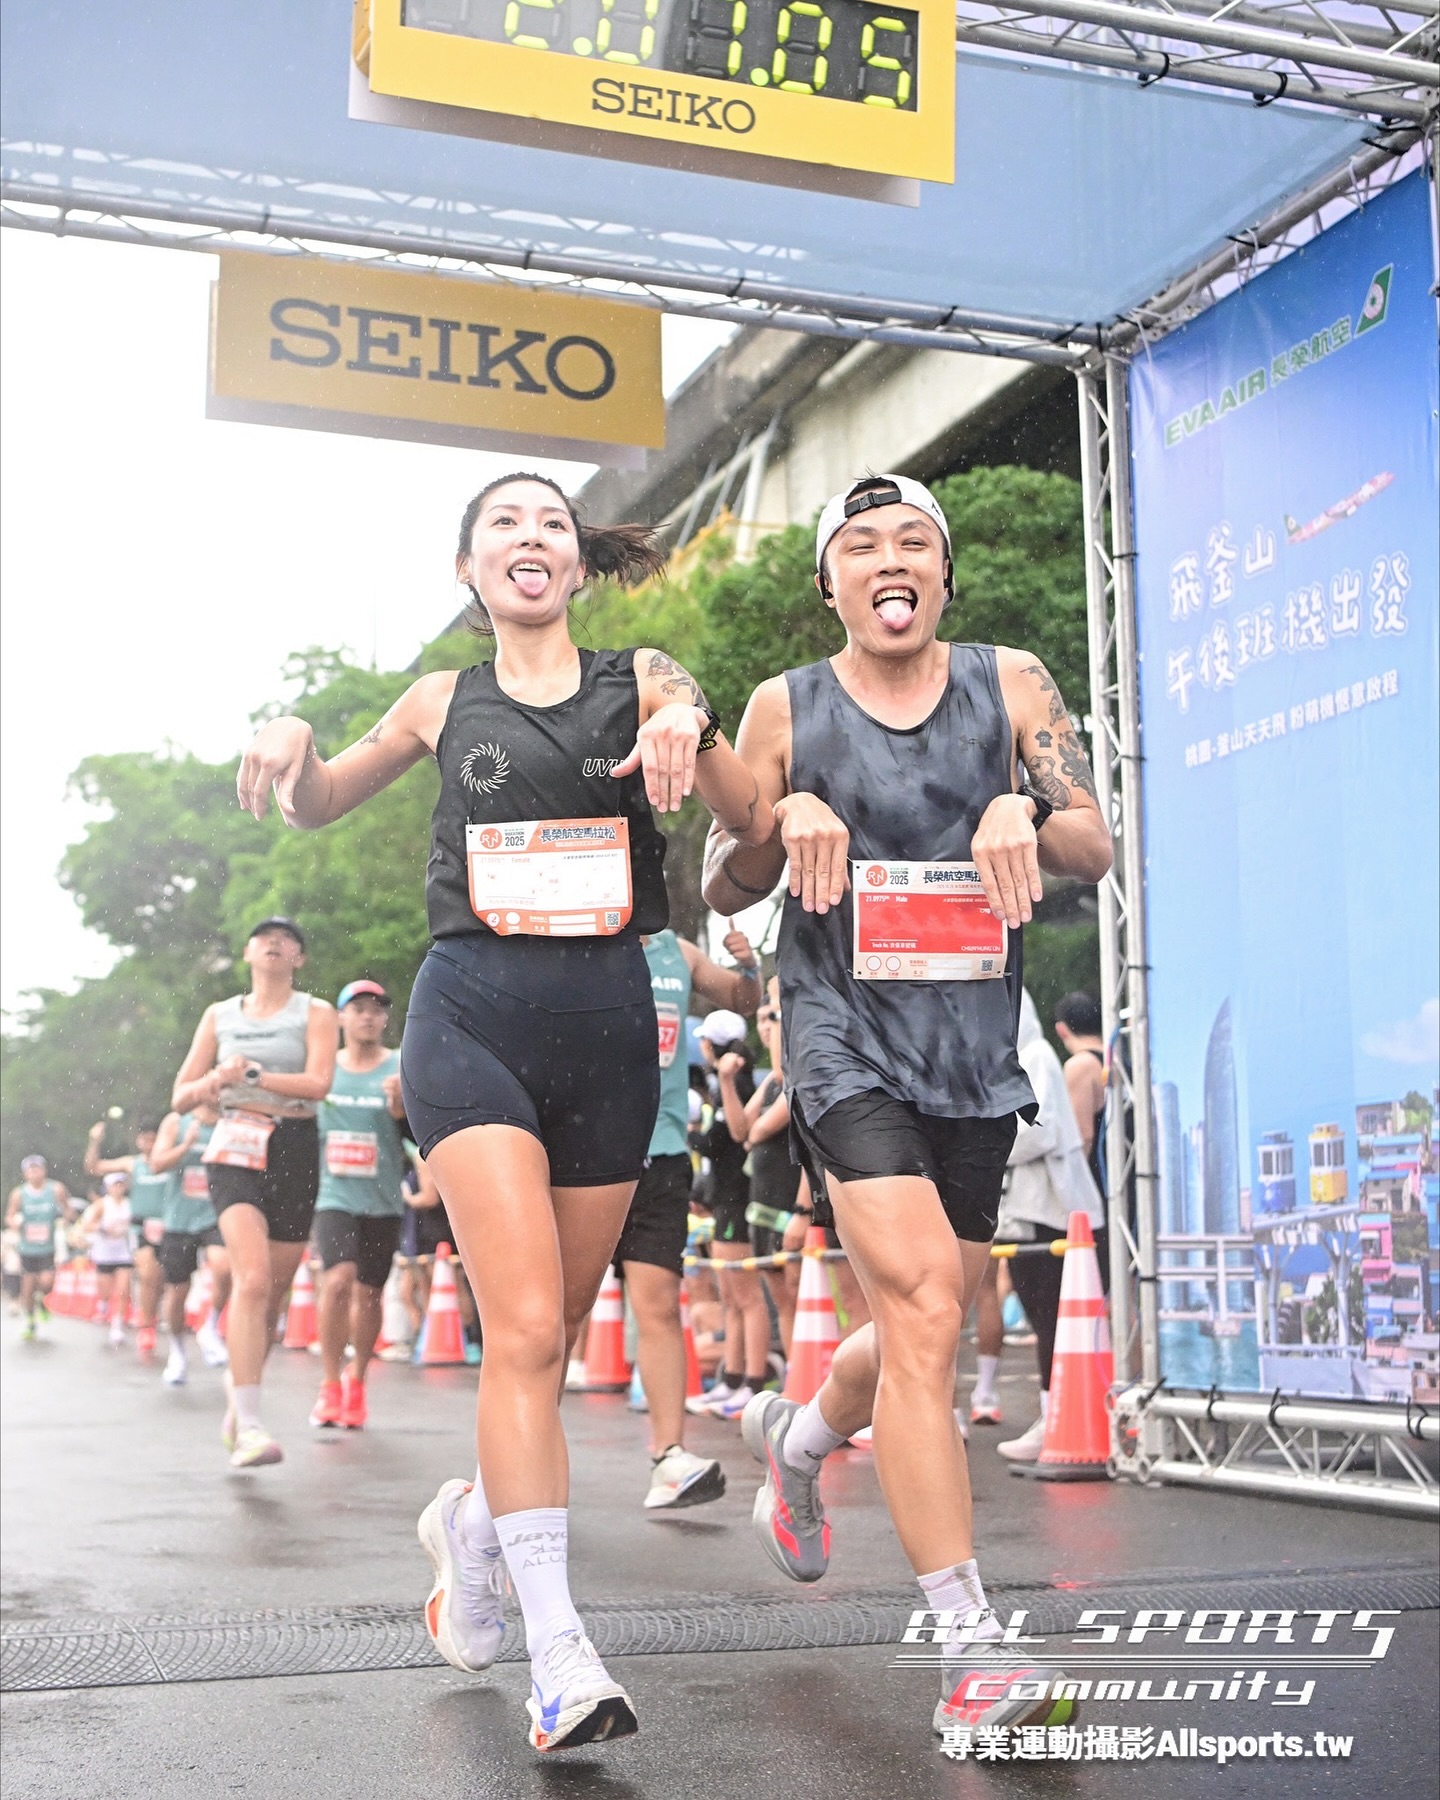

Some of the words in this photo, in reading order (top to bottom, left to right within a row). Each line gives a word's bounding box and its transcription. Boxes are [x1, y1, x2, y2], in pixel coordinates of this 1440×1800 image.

[591, 77, 756, 134] SEIKO
[269, 297, 616, 401] SEIKO
[1270, 314, 1352, 386] 長榮航空
[1170, 523, 1275, 618] 飛釜山
[1167, 554, 1409, 711] 午後班機出發
[505, 836, 525, 847] 2025
[540, 826, 616, 843] 長榮航空馬拉松
[890, 875, 909, 885] 2025
[651, 976, 683, 992] AIR
